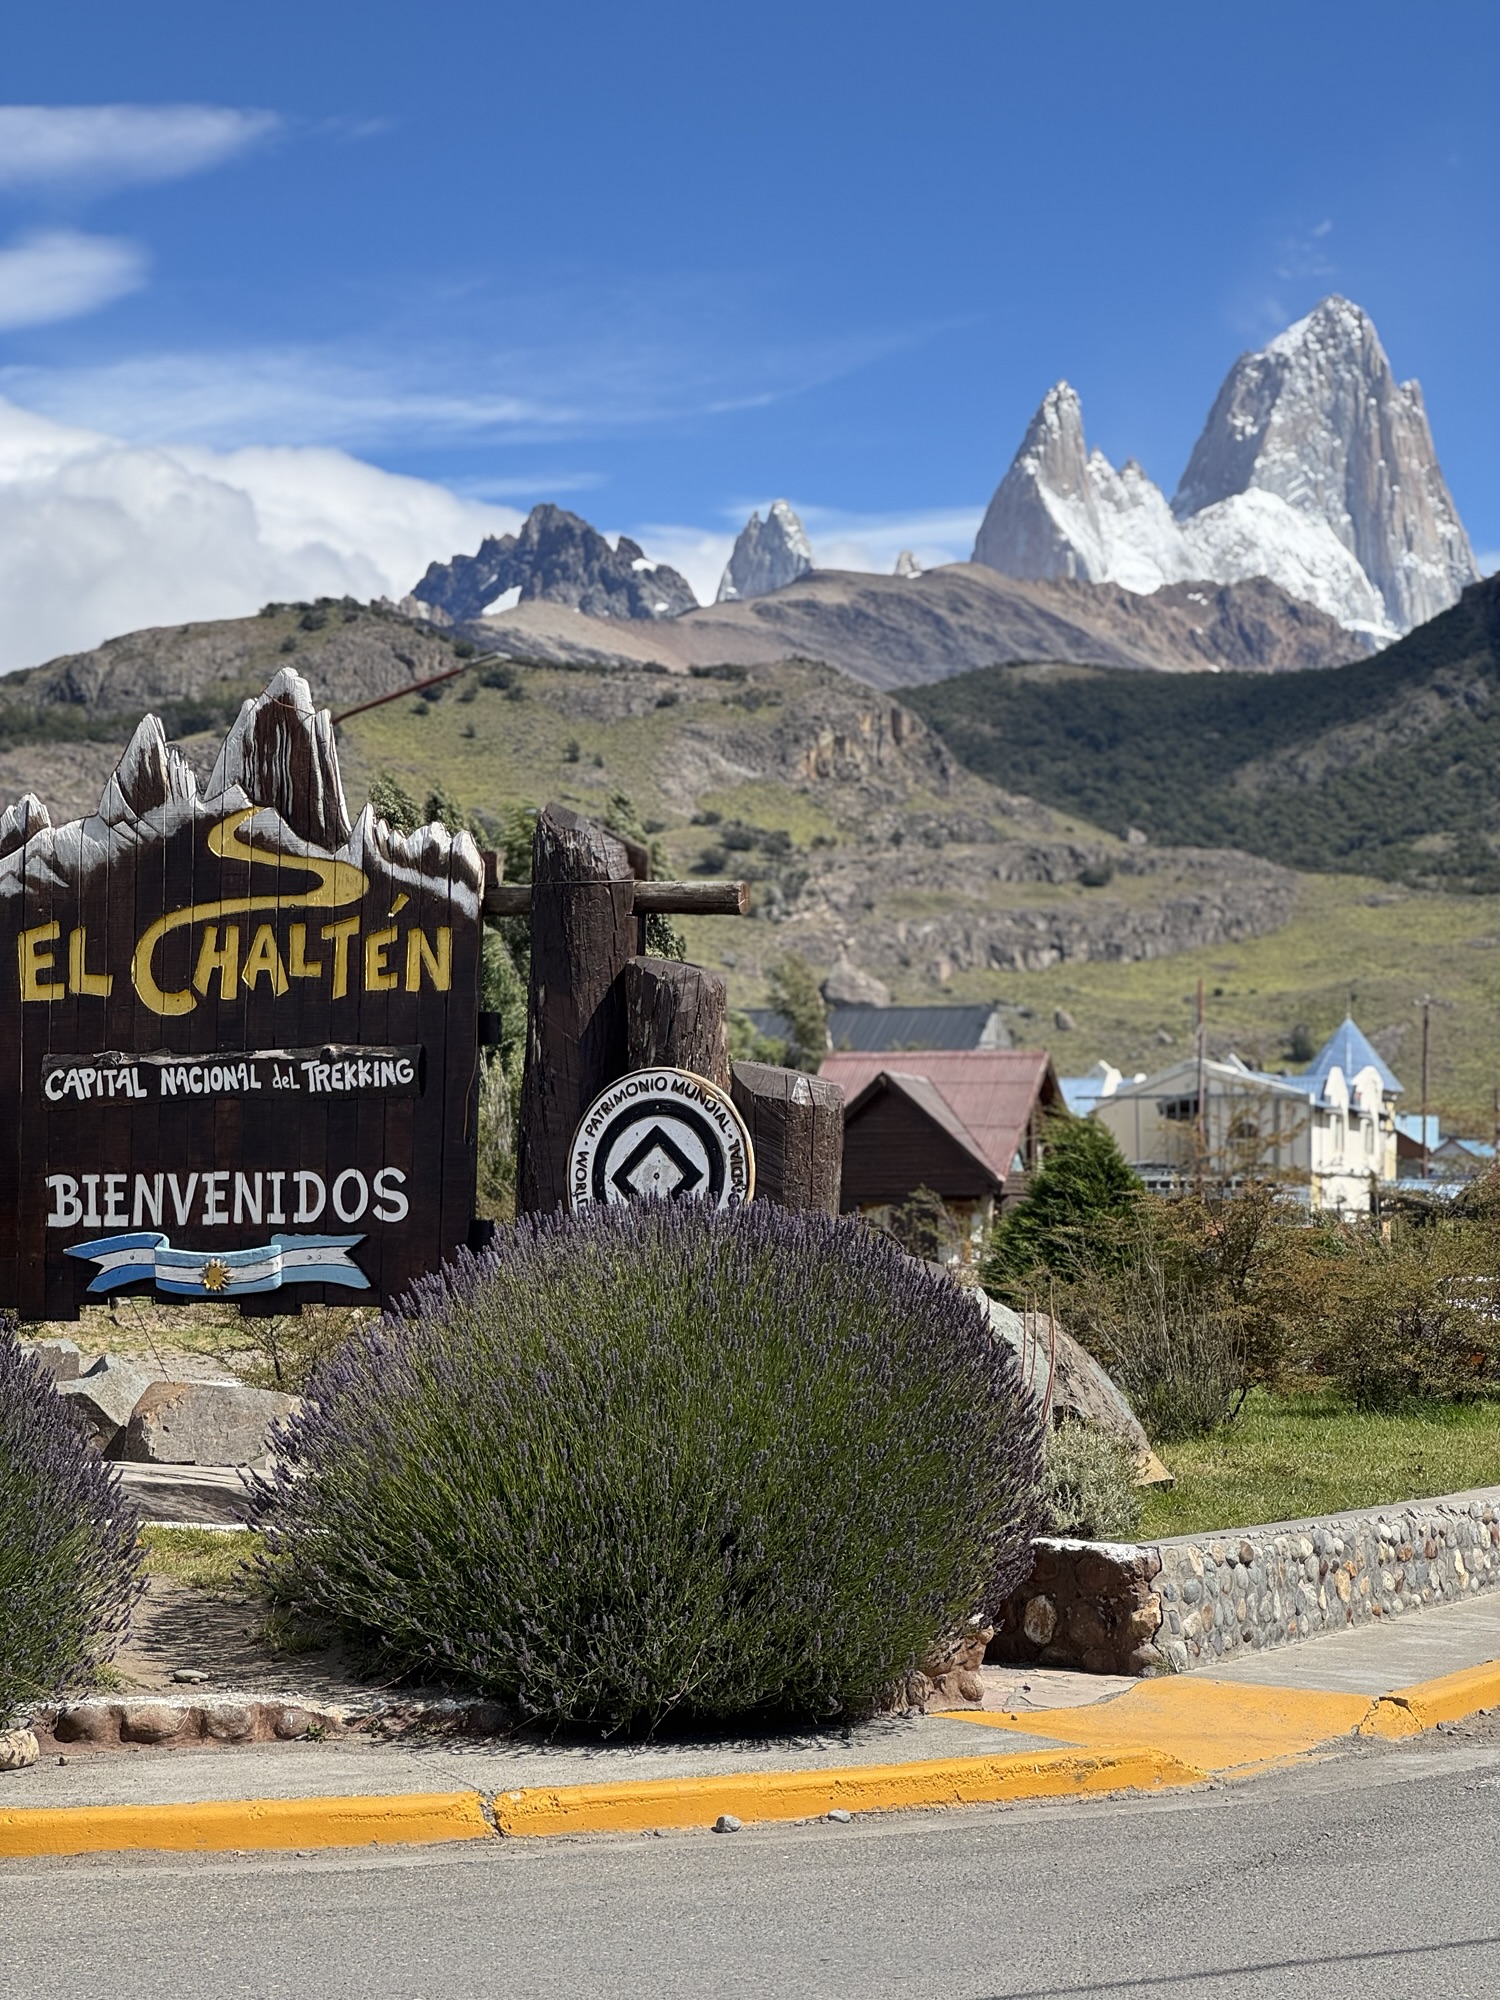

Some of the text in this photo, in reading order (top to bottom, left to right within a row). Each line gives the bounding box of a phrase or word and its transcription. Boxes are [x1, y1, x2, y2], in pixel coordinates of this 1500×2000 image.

[18, 893, 453, 1016] EL CHALTÉN
[44, 1067, 148, 1101] CAPITAL
[160, 1062, 262, 1096] NACIONAL
[301, 1059, 414, 1092] TREKKING
[584, 1076, 731, 1138] PATRIMONIO MUNDIAL
[45, 1167, 410, 1228] BIENVENIDOS
[727, 1138, 744, 1207] ONDIAL
